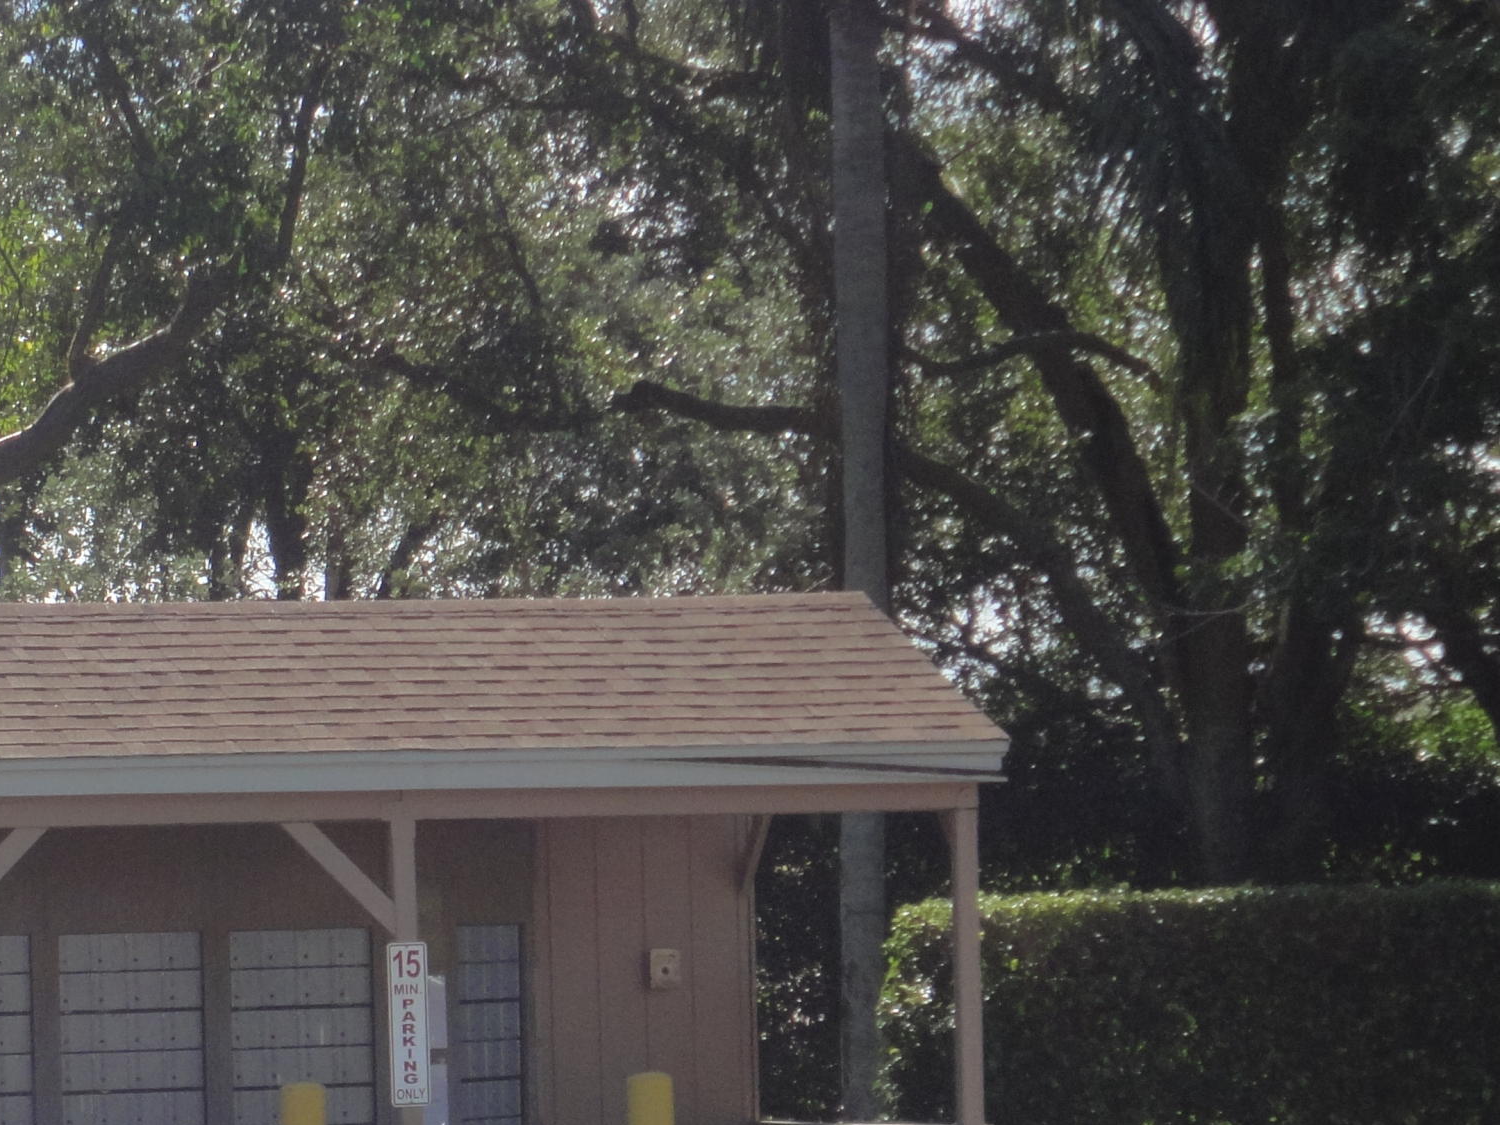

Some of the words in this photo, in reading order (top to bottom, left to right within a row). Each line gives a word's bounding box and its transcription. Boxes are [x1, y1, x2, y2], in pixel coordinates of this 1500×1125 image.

[392, 950, 421, 979] 15
[394, 984, 423, 996] MIN.
[402, 998, 418, 1085] PARKING
[396, 1088, 426, 1100] ONLY
